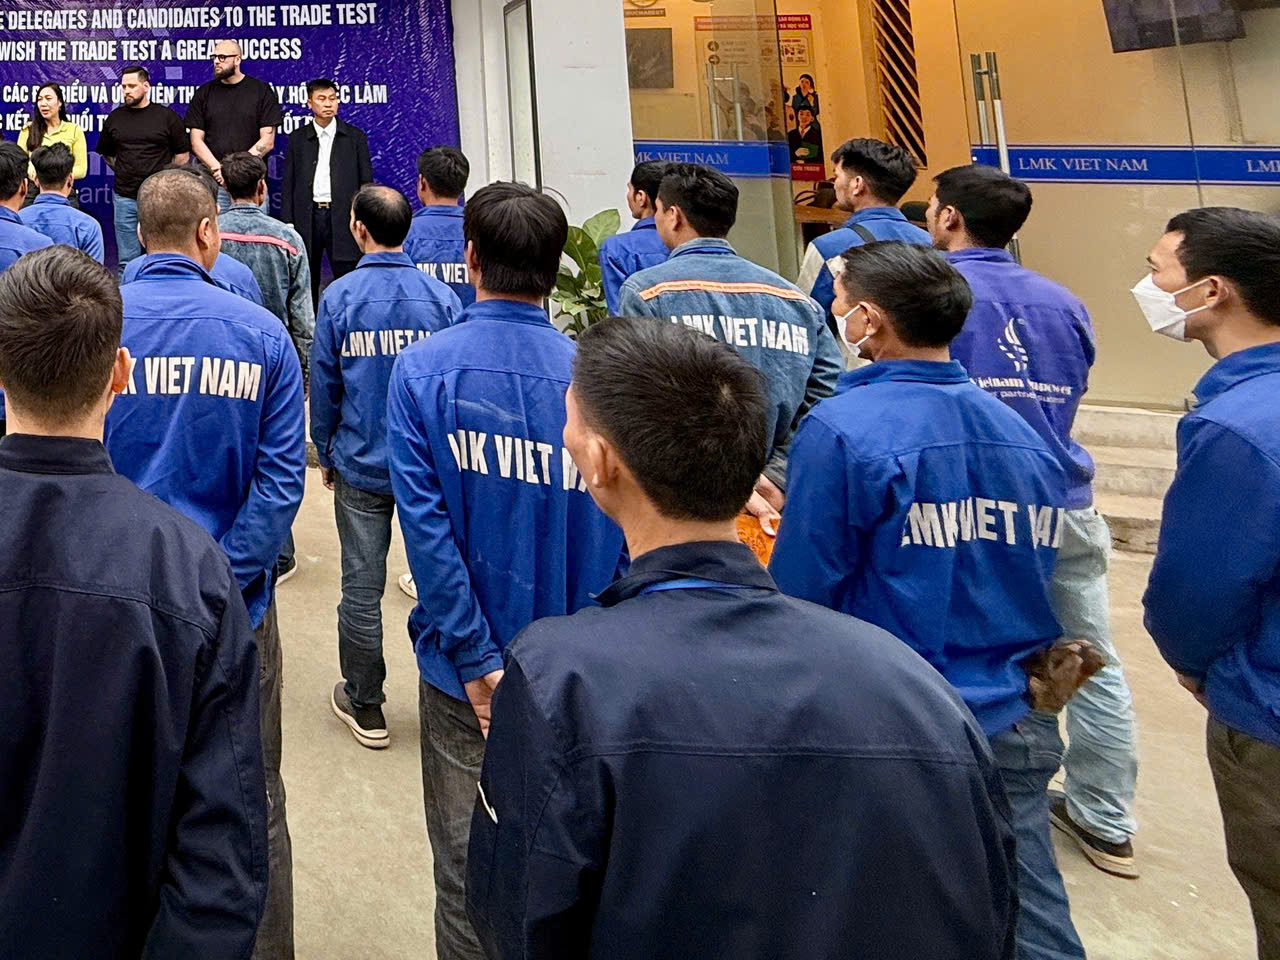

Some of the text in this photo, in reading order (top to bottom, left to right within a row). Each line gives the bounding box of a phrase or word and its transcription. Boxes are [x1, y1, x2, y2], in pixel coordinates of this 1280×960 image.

[8, 9, 87, 30] DELEGATES
[92, 9, 122, 29] AND
[127, 6, 220, 29] CANDIDATES
[224, 6, 243, 27] TO
[247, 6, 275, 27] THE
[280, 4, 332, 26] TRADE
[336, 3, 377, 25] TEST
[39, 41, 66, 61] THE
[71, 40, 117, 61] TRADE
[121, 40, 156, 61] TEST
[161, 40, 171, 61] A
[239, 38, 302, 60] UCCESS
[3, 82, 29, 103] CÁC
[91, 82, 108, 103] VÀ
[149, 82, 174, 104] IÊN
[178, 85, 200, 104] TH
[288, 82, 309, 108] HỘ
[354, 81, 387, 104] LÀM
[6, 108, 30, 130] KẾT
[634, 152, 653, 163] MK
[694, 152, 728, 165] NAM
[1019, 158, 1149, 171] LMK VIET NAM
[441, 262, 469, 283] VIET
[341, 329, 414, 357] LMK VIET
[761, 319, 809, 355] NAM
[144, 357, 195, 394] VIET
[200, 357, 262, 402] NAM
[494, 434, 553, 485] VIET
